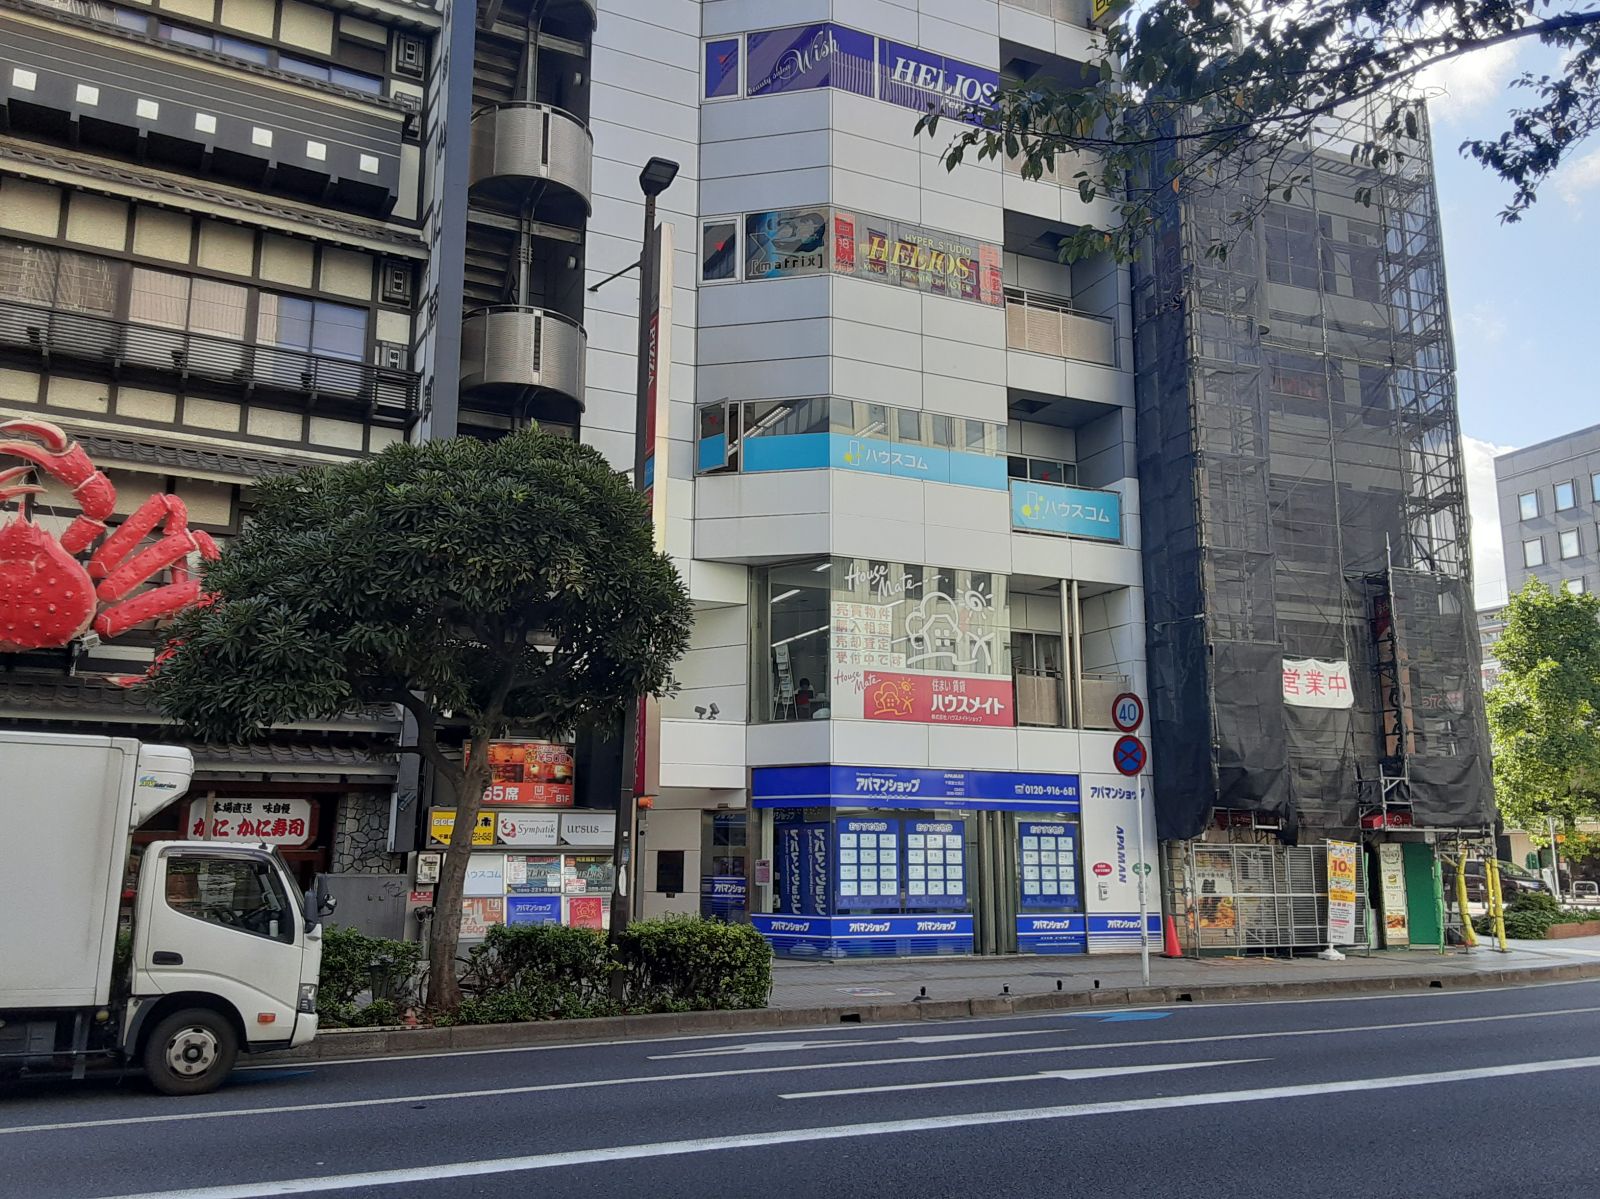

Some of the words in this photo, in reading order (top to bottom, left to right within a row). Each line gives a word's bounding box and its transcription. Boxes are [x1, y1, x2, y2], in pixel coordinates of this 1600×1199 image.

[776, 30, 839, 79] Wish
[892, 56, 998, 107] HELIOS
[904, 233, 934, 249] HYPER
[938, 241, 972, 257] STUDIO
[867, 236, 971, 280] HELIOS
[865, 448, 929, 470] ハウスコム
[1044, 500, 1111, 523] ハウスコム
[844, 563, 889, 591] House
[877, 572, 923, 603] Mate
[833, 669, 862, 686] House
[1282, 668, 1347, 698] 営業中
[931, 694, 1005, 716] ハウスメイト
[1119, 703, 1137, 721] 40
[856, 777, 921, 793] アパマンショップ
[1090, 786, 1145, 800] アパマンショッ
[213, 802, 253, 814] 本場直送
[262, 802, 291, 815] 味自慢
[1115, 825, 1127, 884] APAMAN
[789, 829, 801, 915] アパマンショップ
[814, 829, 826, 916] アパマンショップ
[771, 921, 810, 931] アパマンショップ
[849, 922, 890, 932] アパマンショップ
[916, 921, 957, 931] アパマンショップ
[1032, 920, 1070, 930] アパマンショップ
